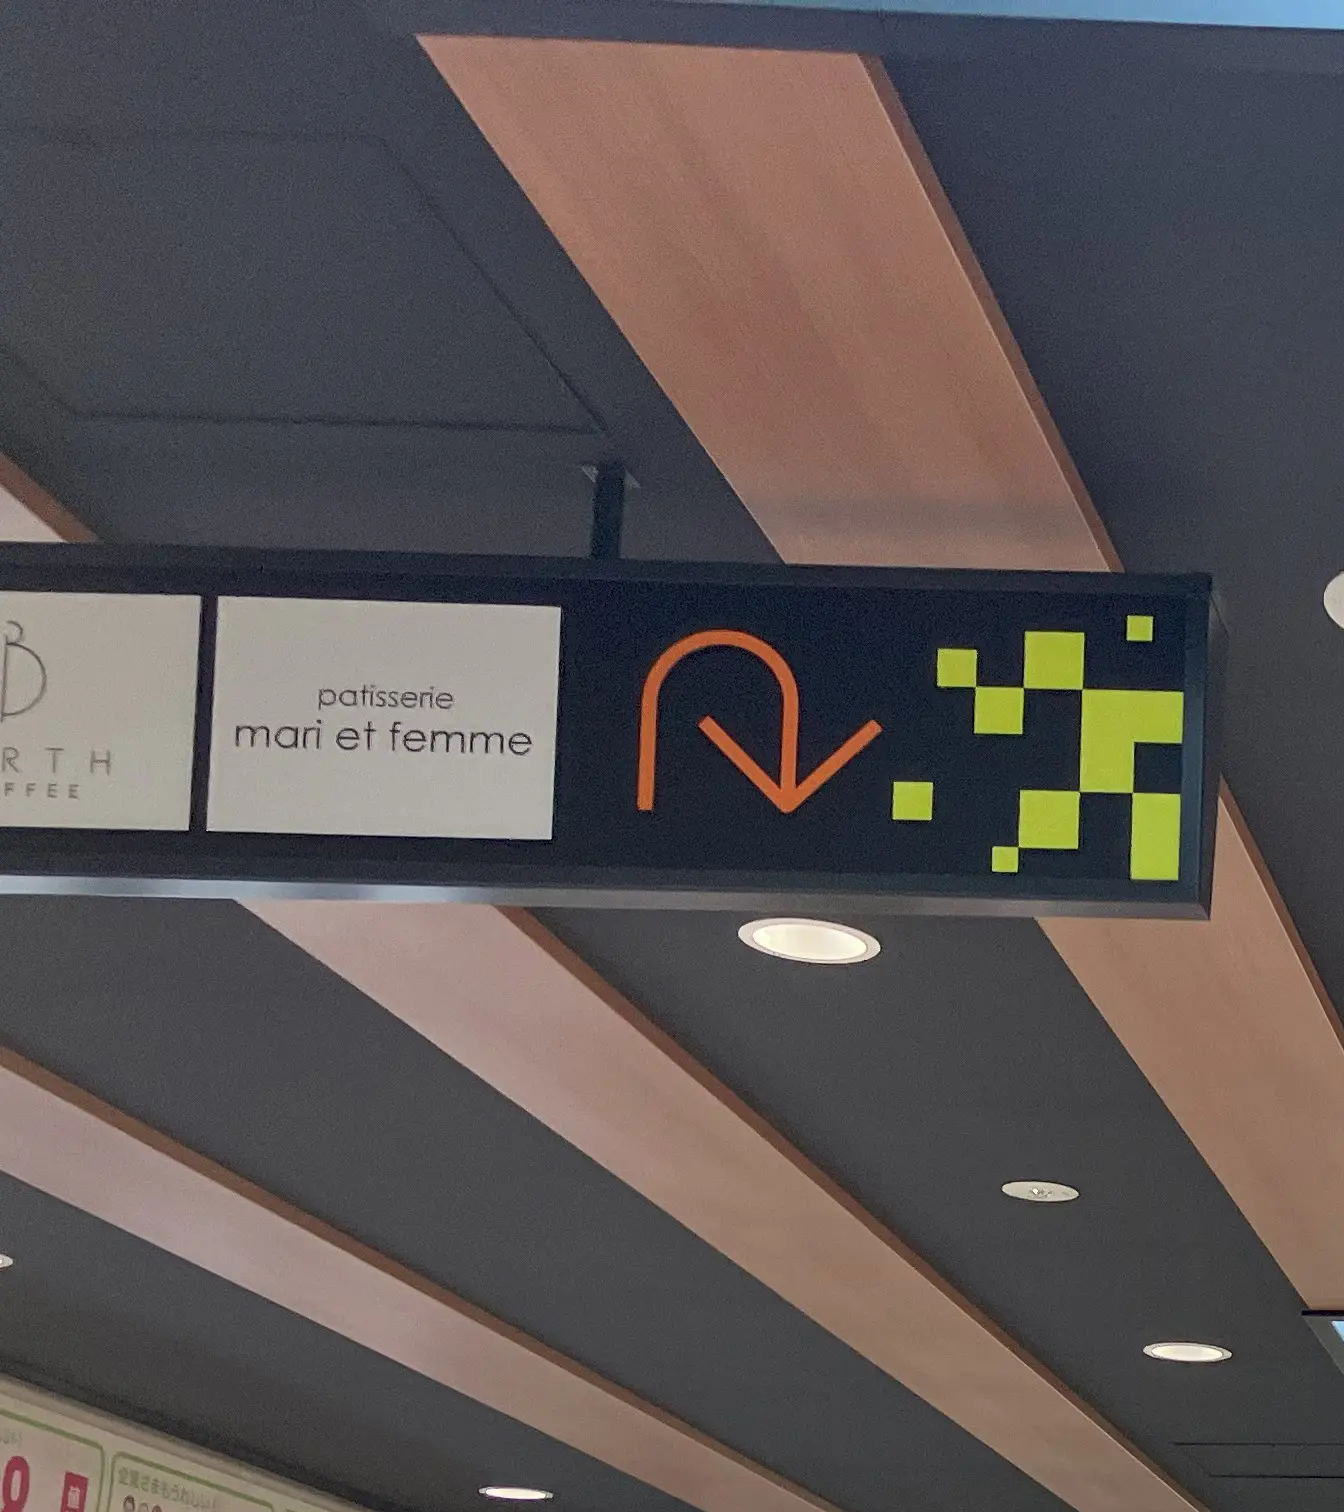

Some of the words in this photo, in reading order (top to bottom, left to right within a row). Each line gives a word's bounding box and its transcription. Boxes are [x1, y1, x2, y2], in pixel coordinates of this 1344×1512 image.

[317, 684, 455, 711] patisserie
[234, 719, 322, 750] mari
[336, 721, 376, 751] et
[390, 720, 534, 757] femme
